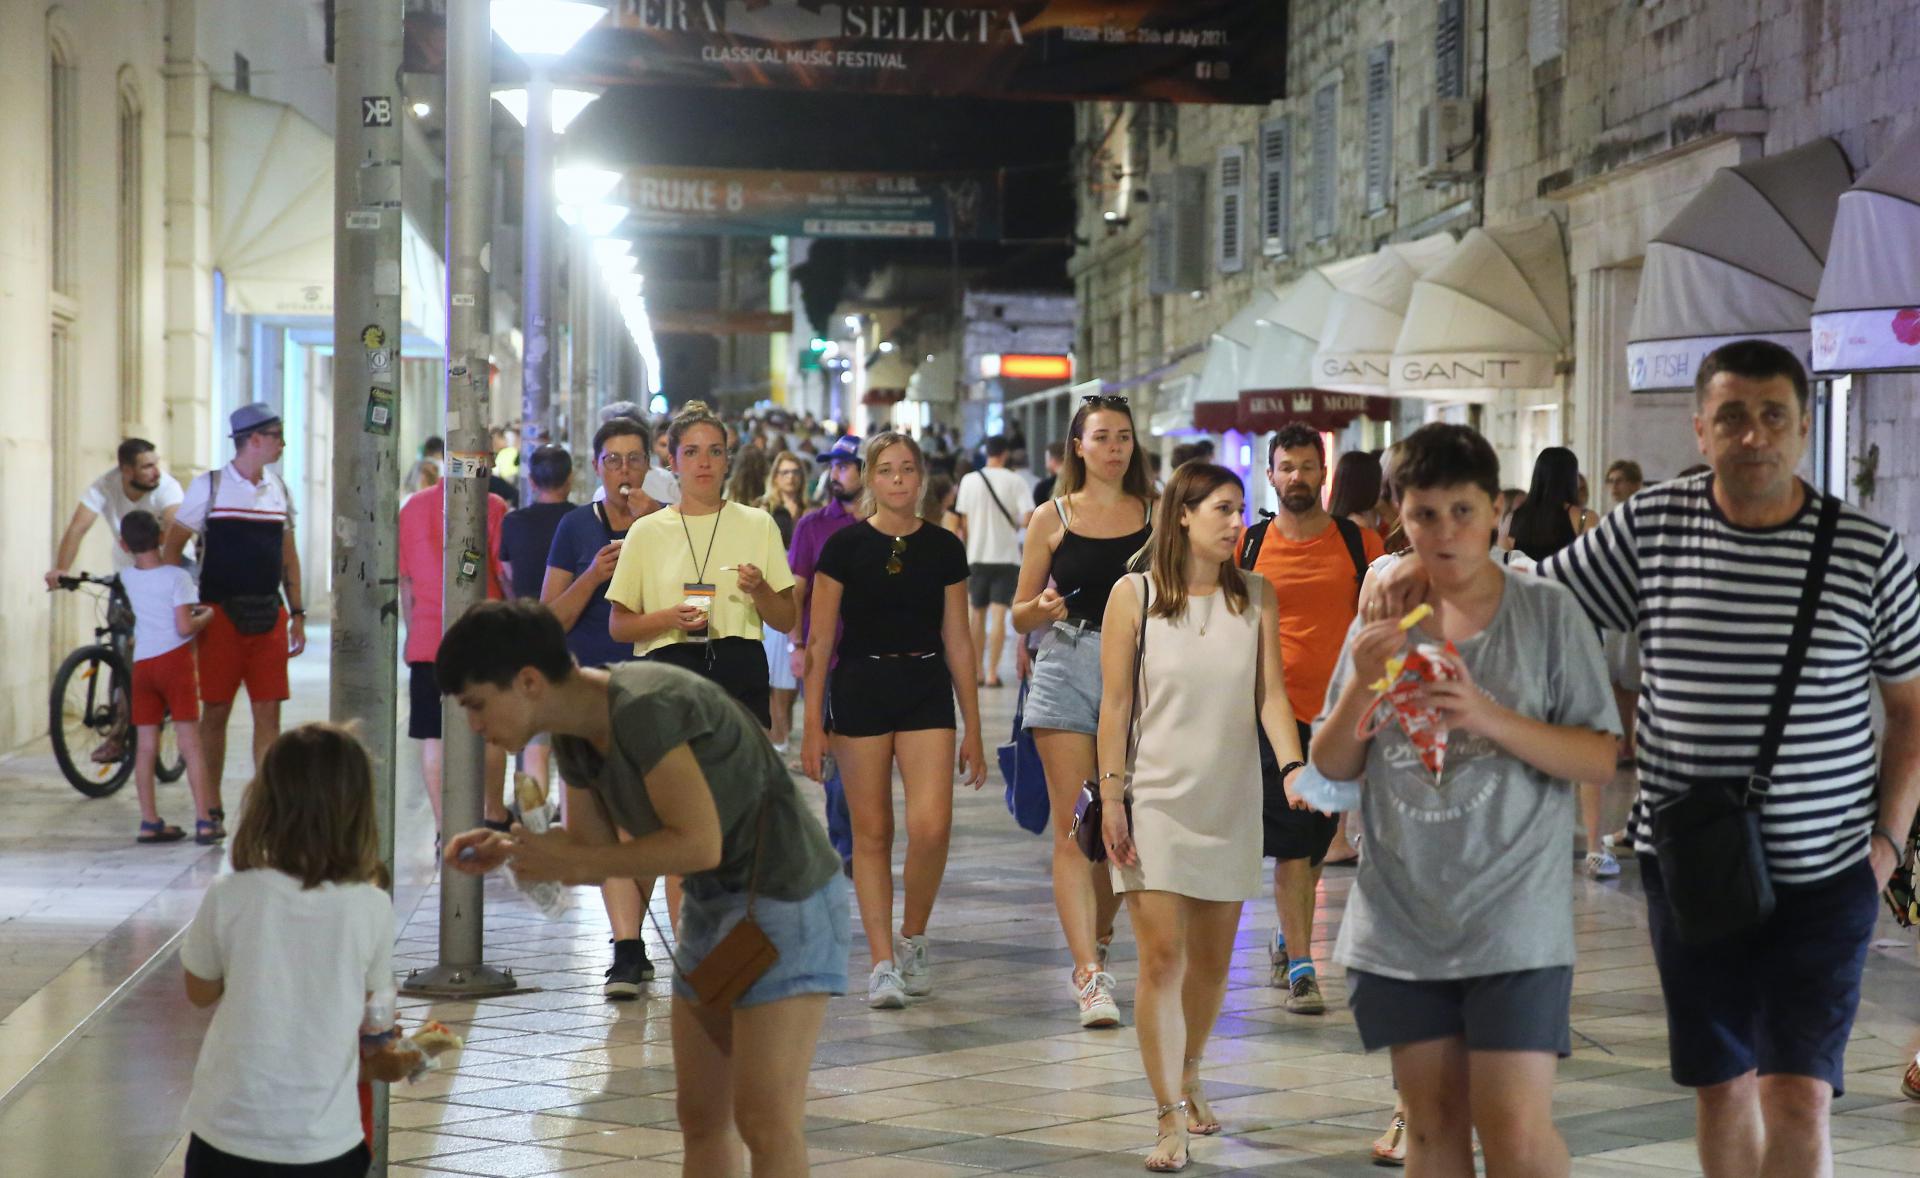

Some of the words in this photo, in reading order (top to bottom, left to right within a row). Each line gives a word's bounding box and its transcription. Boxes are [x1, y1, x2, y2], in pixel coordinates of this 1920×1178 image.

[610, 0, 718, 32] PERA
[845, 5, 1024, 45] SELECTA
[702, 46, 783, 63] CLASSICAL
[786, 50, 832, 66] MUSIC
[836, 51, 906, 69] FESTIVAL
[1322, 358, 1390, 378] GAN
[1402, 359, 1520, 381] GANT
[1654, 353, 1690, 378] FISH
